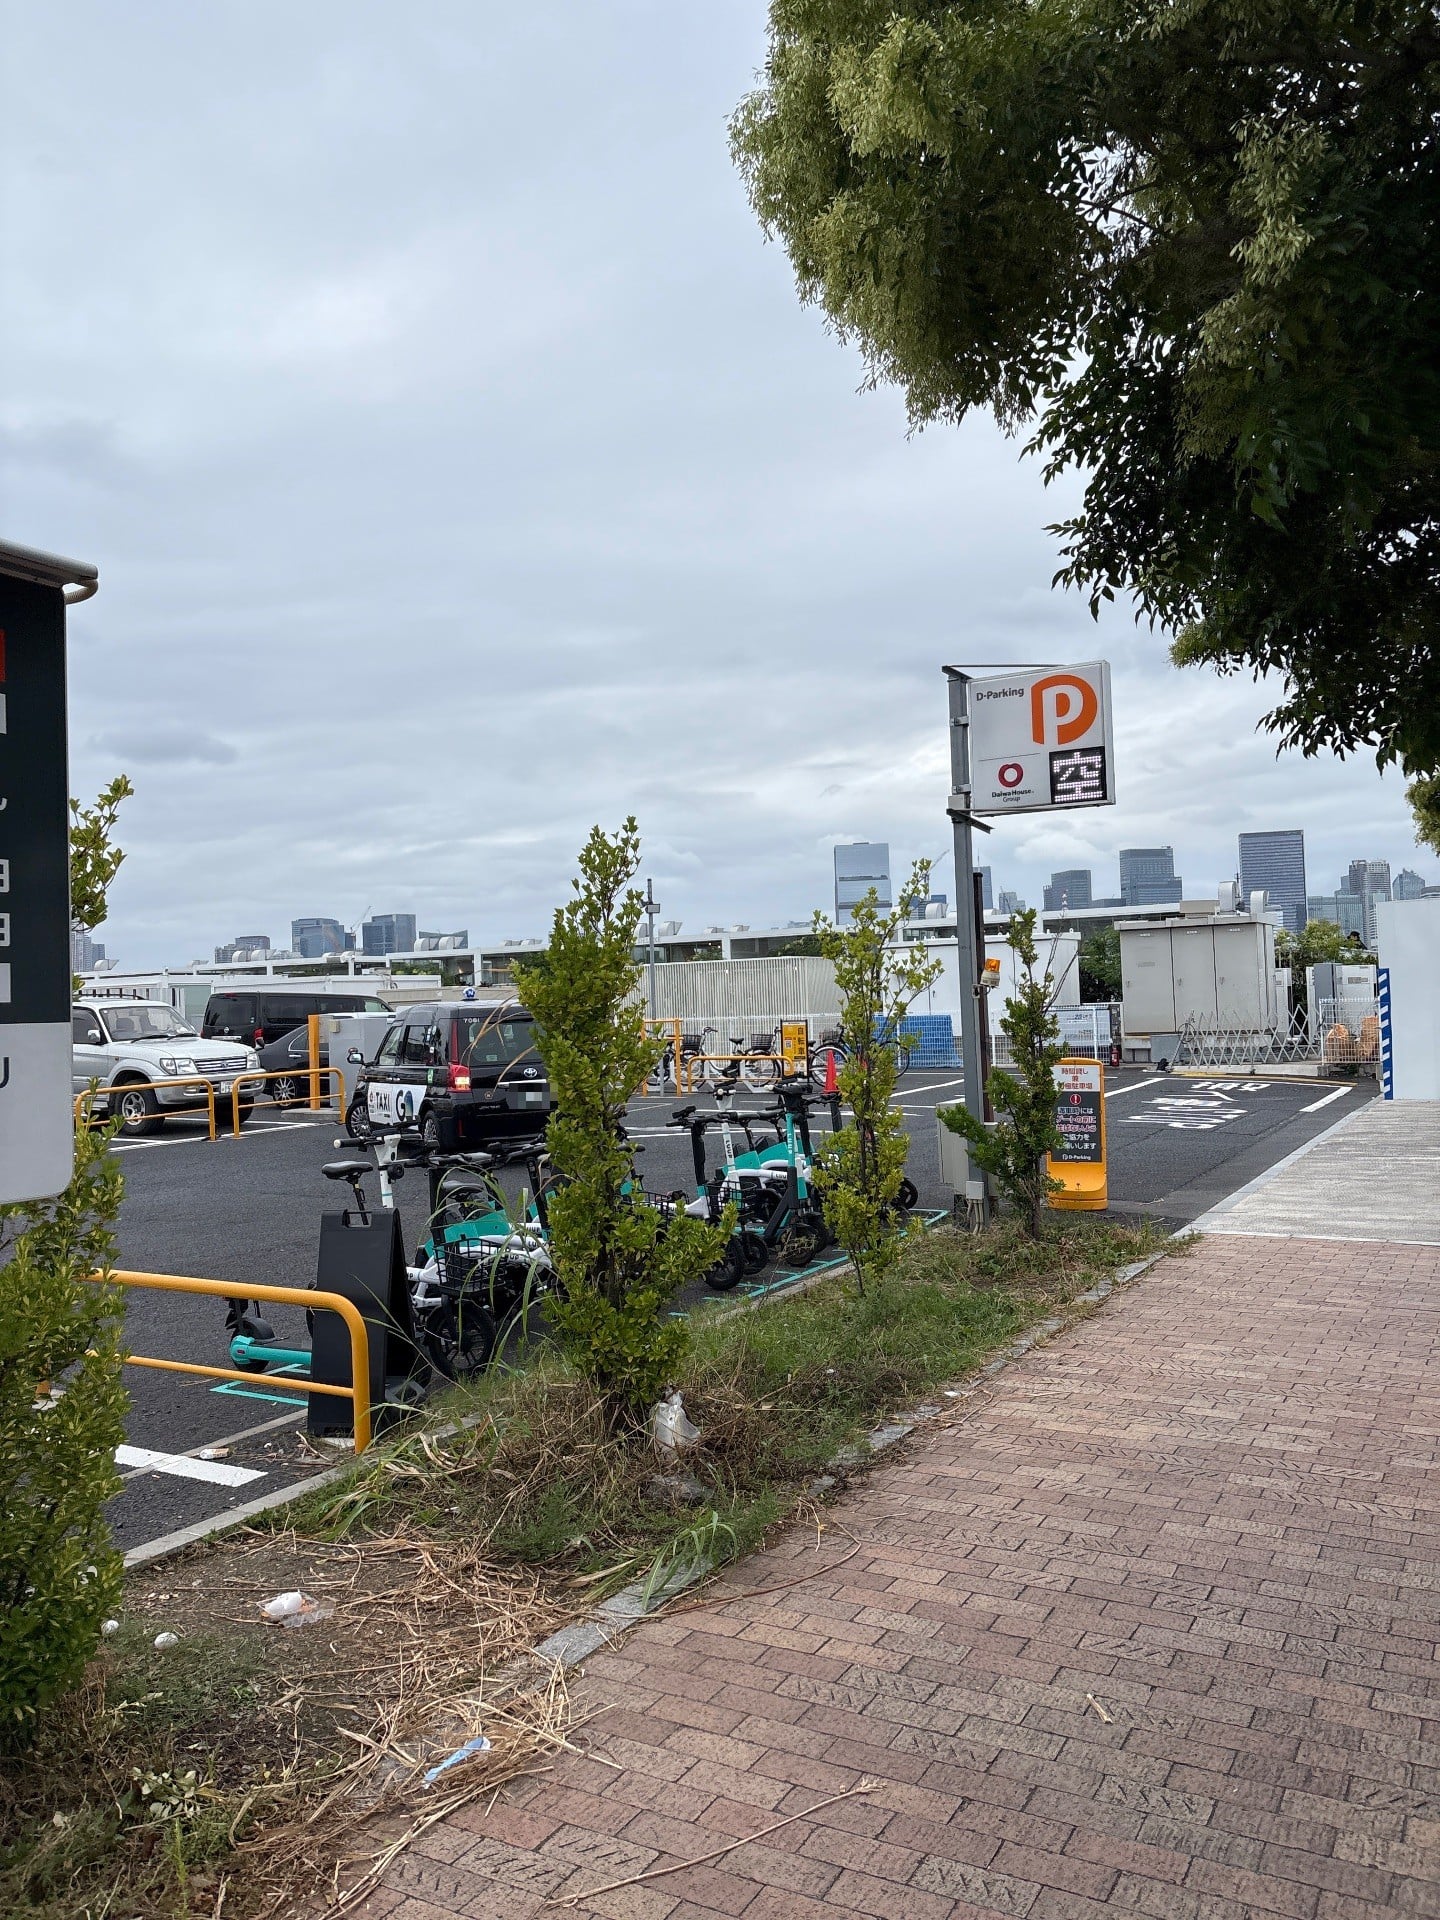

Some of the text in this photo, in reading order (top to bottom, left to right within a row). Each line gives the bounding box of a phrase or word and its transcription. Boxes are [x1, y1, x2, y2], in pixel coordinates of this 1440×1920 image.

[976, 687, 1025, 701] D-Parking
[1053, 752, 1103, 802] 空
[375, 1091, 391, 1112] TAXI
[725, 1140, 733, 1159] LUUP
[1056, 1142, 1097, 1150] 願いします
